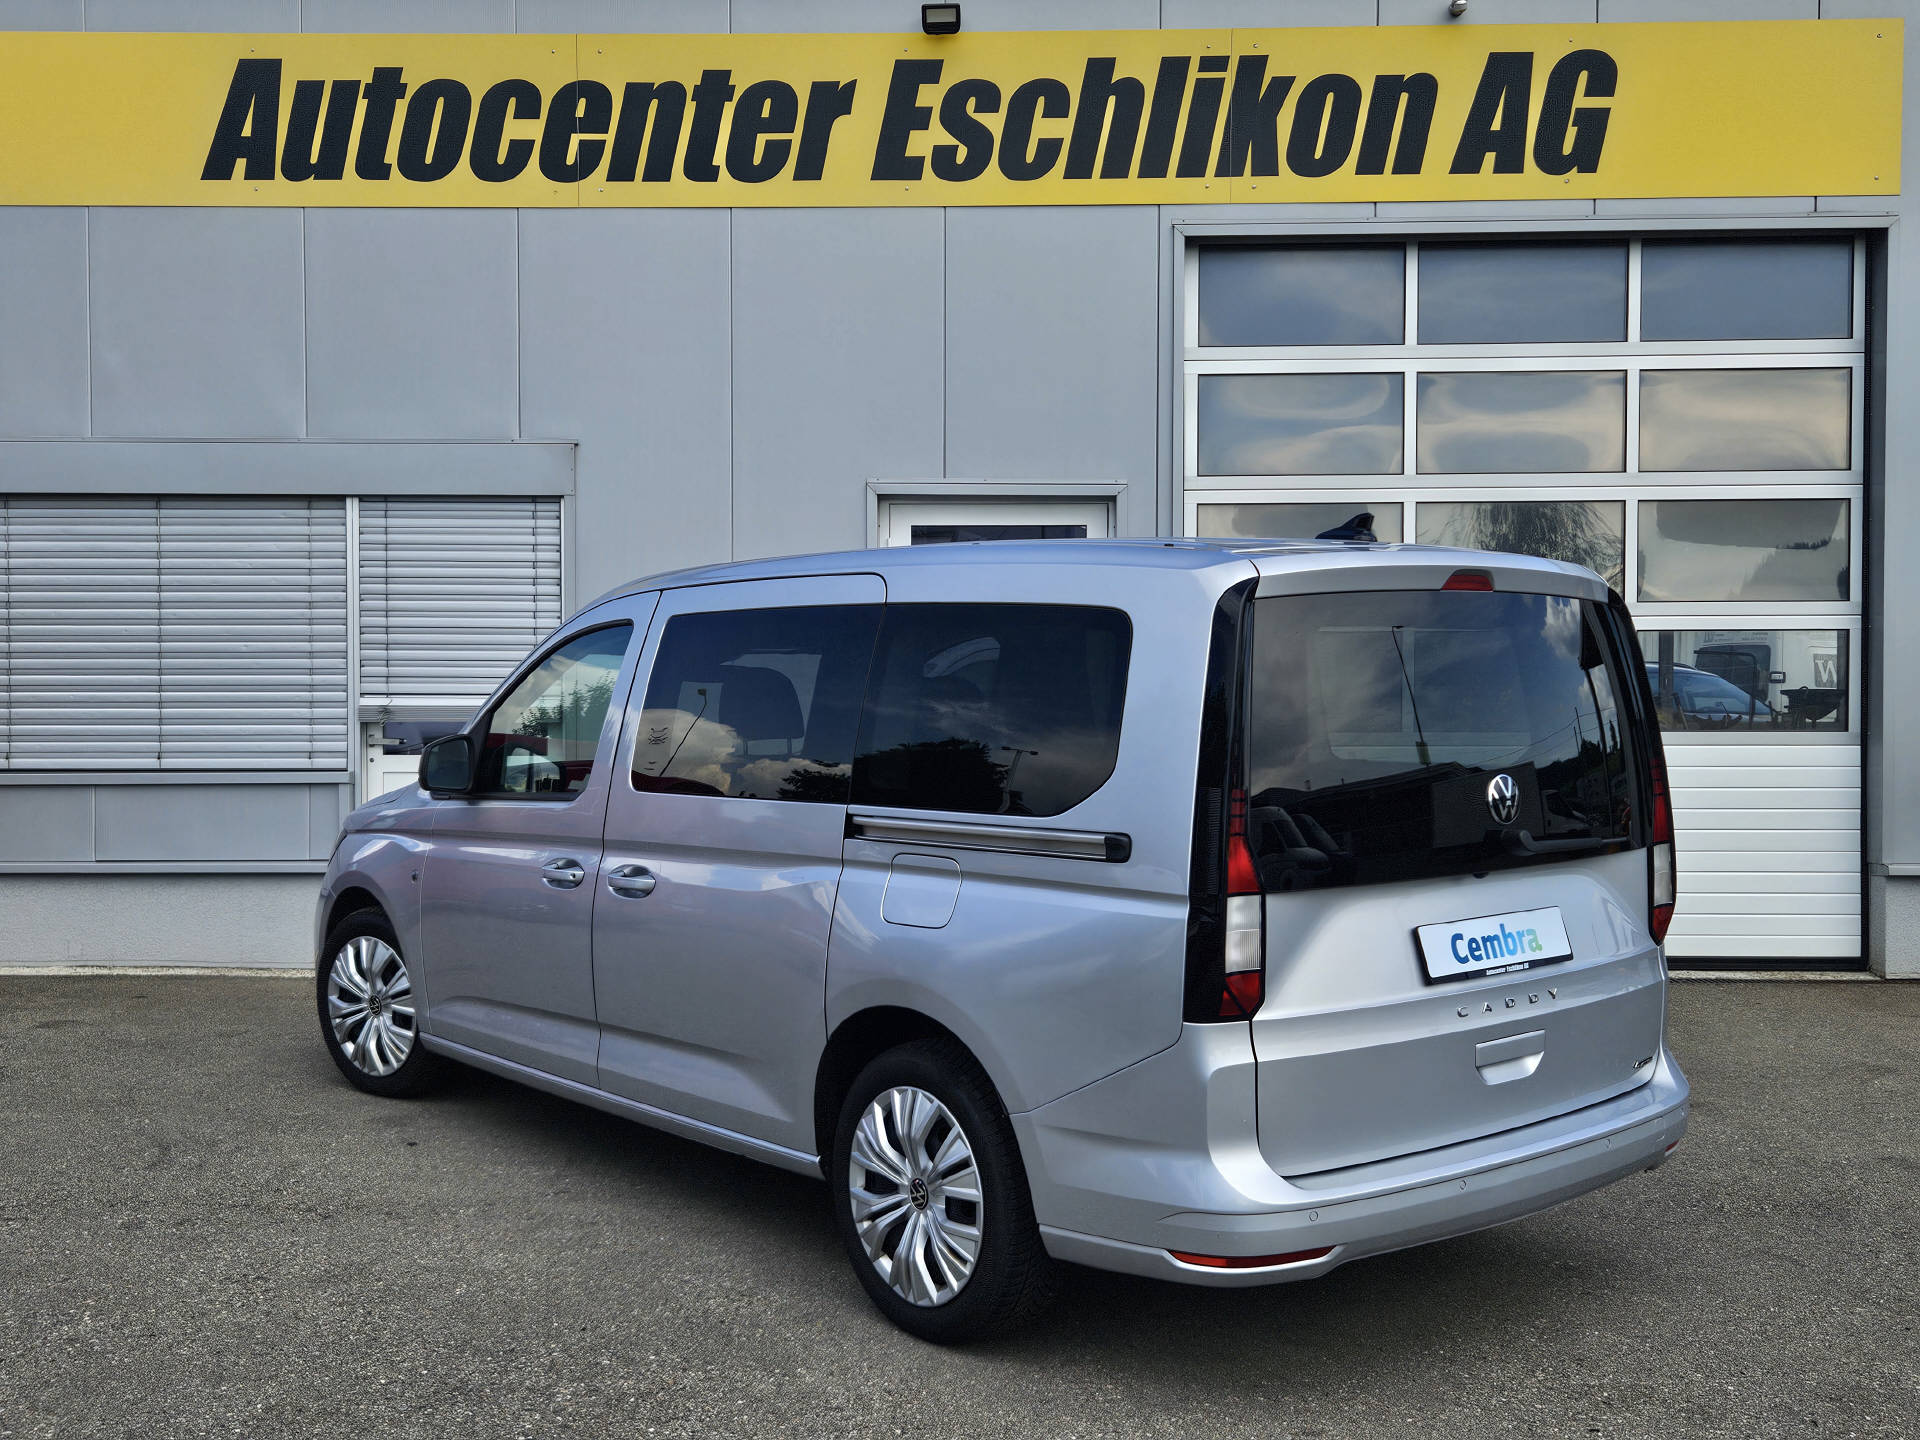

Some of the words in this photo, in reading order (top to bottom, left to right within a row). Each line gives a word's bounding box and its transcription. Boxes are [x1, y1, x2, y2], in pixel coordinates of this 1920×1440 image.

[200, 58, 858, 184] Autocenter
[870, 54, 1440, 182] Eschlikon
[1449, 48, 1619, 176] AG
[1450, 922, 1543, 965] Cembra
[1456, 987, 1558, 1018] CADDY
